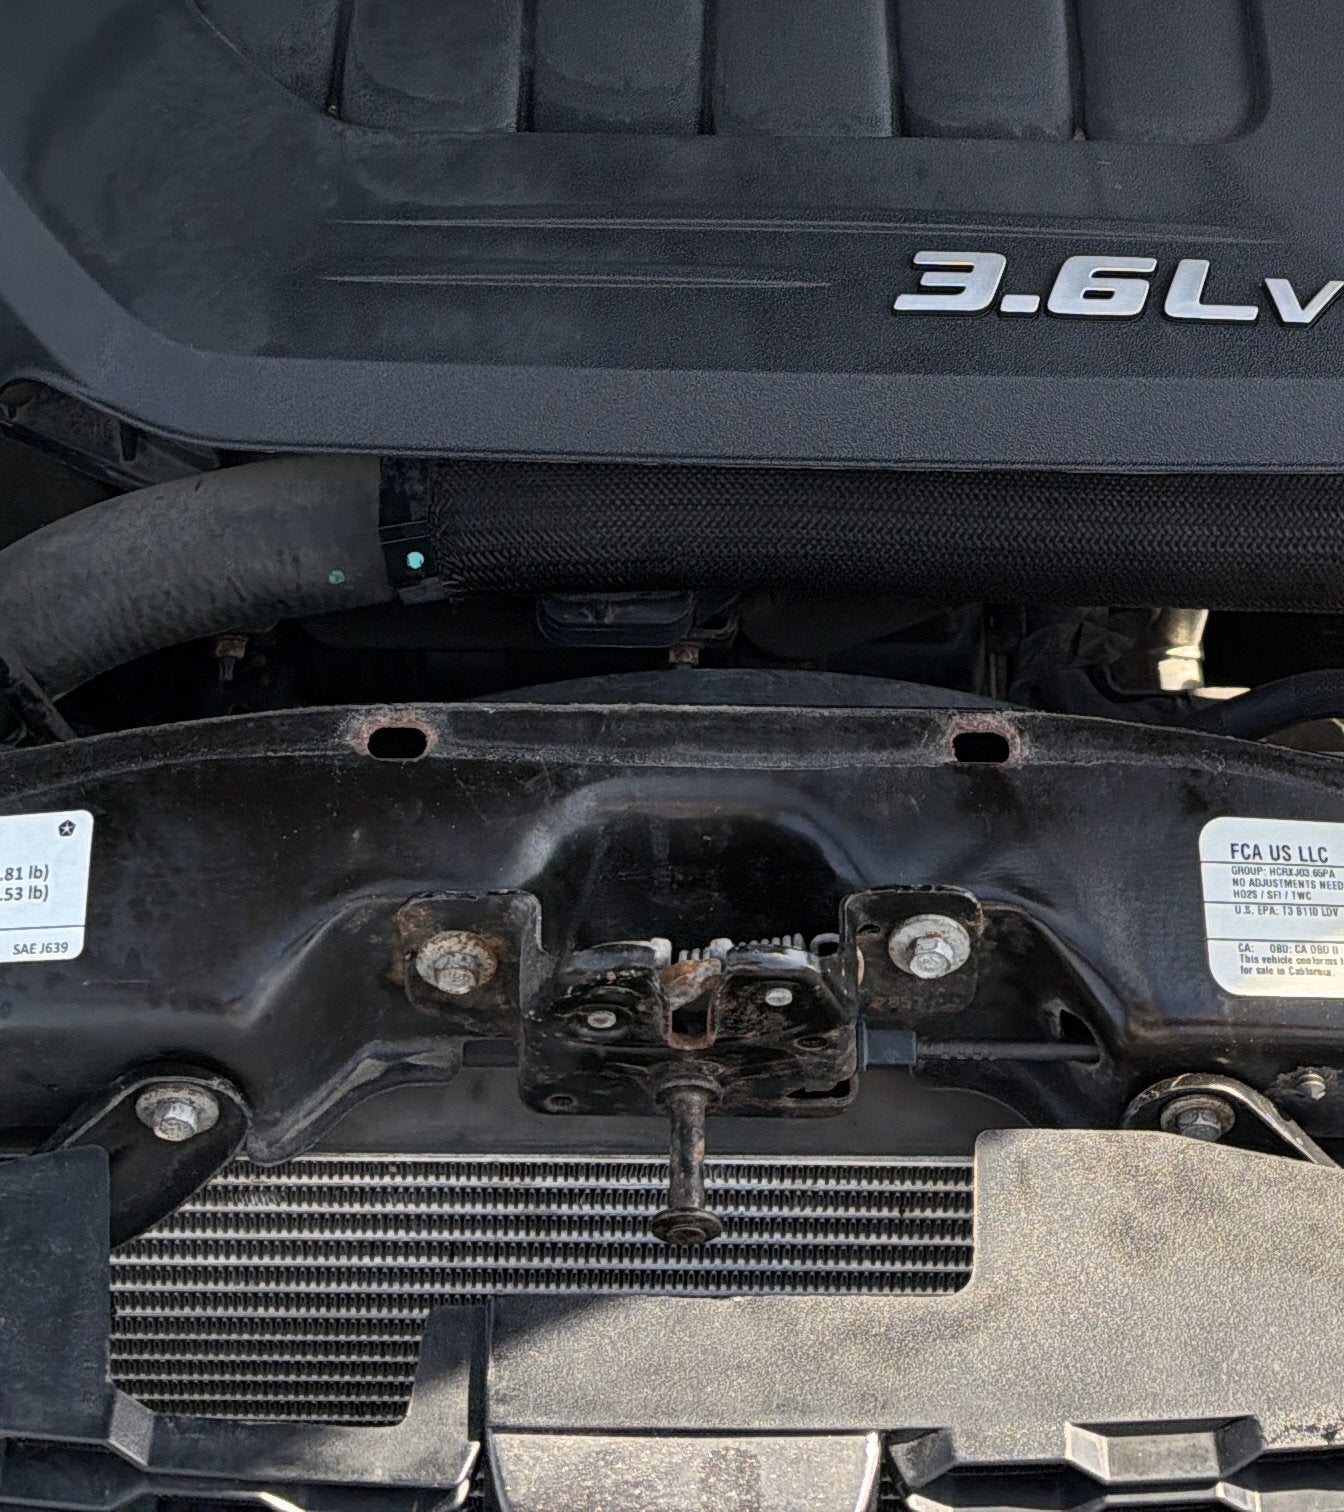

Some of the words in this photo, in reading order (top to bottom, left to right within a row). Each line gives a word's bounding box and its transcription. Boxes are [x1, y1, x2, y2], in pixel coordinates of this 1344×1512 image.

[892, 249, 1260, 321] 3.6L
[1228, 841, 1262, 861] FCA
[1268, 843, 1293, 862] US
[1297, 845, 1329, 864] LLC
[29, 864, 49, 882] lb)
[1230, 864, 1267, 876] GROUP:
[1231, 875, 1246, 887] NO
[1248, 876, 1316, 890] ADJUSTMENTS
[28, 884, 49, 903] lb)
[1266, 889, 1282, 900] SFI
[1290, 890, 1312, 901] TWC
[1233, 903, 1254, 915] U.S.
[1256, 904, 1279, 915] EPA:
[13, 943, 37, 956] SAE
[40, 942, 69, 955] J639
[1269, 943, 1293, 954] OBD:
[1294, 943, 1308, 954] CA
[1310, 944, 1330, 955] OBD
[1239, 952, 1259, 964] This
[1261, 953, 1293, 965] vehicle
[1295, 955, 1337, 966] conforms
[1239, 963, 1253, 975] for
[1255, 964, 1274, 975] sale
